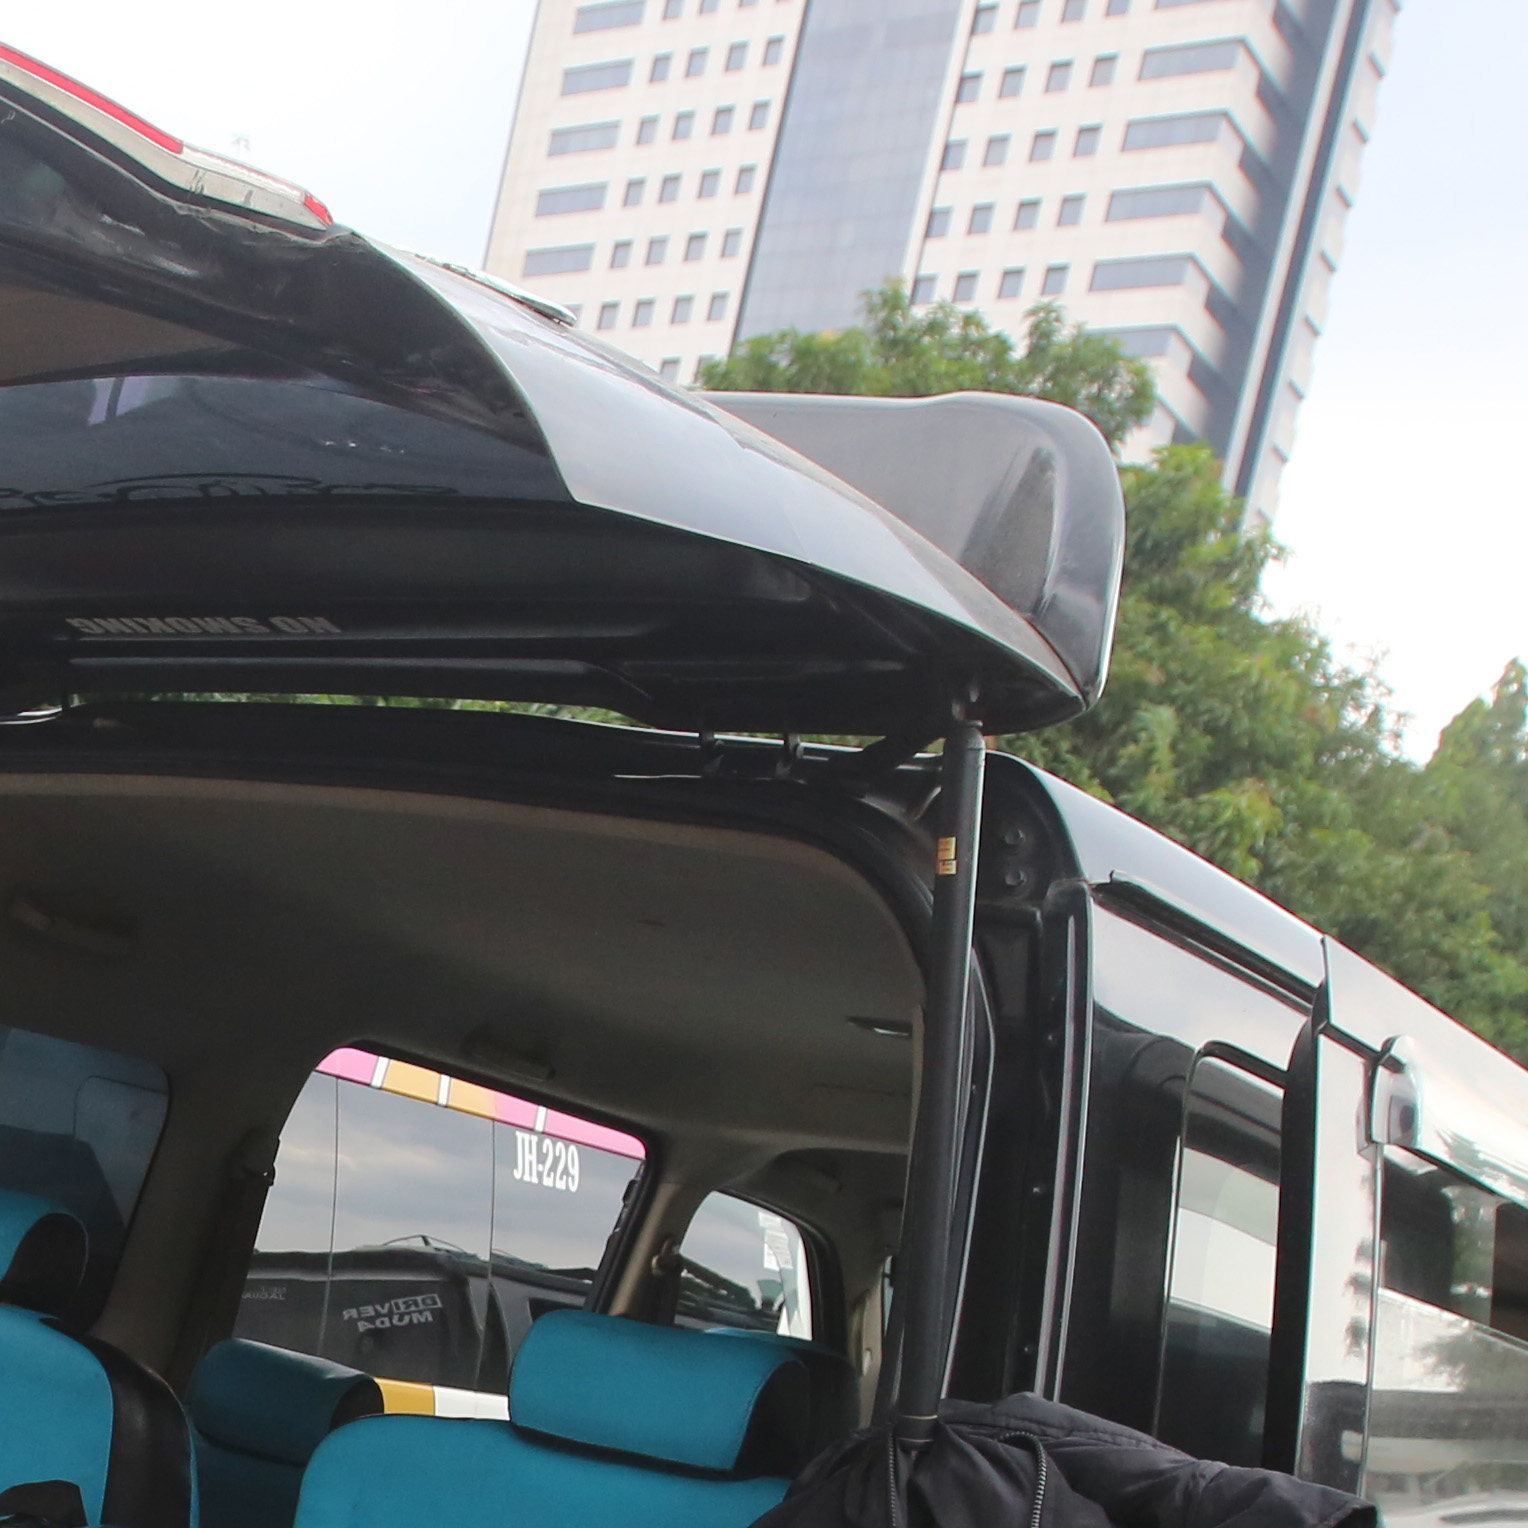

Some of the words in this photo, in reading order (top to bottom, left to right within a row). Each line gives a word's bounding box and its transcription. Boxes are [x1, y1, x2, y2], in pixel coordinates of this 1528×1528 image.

[65, 616, 270, 635] SMOKING
[269, 616, 342, 634] NO
[513, 1130, 580, 1193] JH-229
